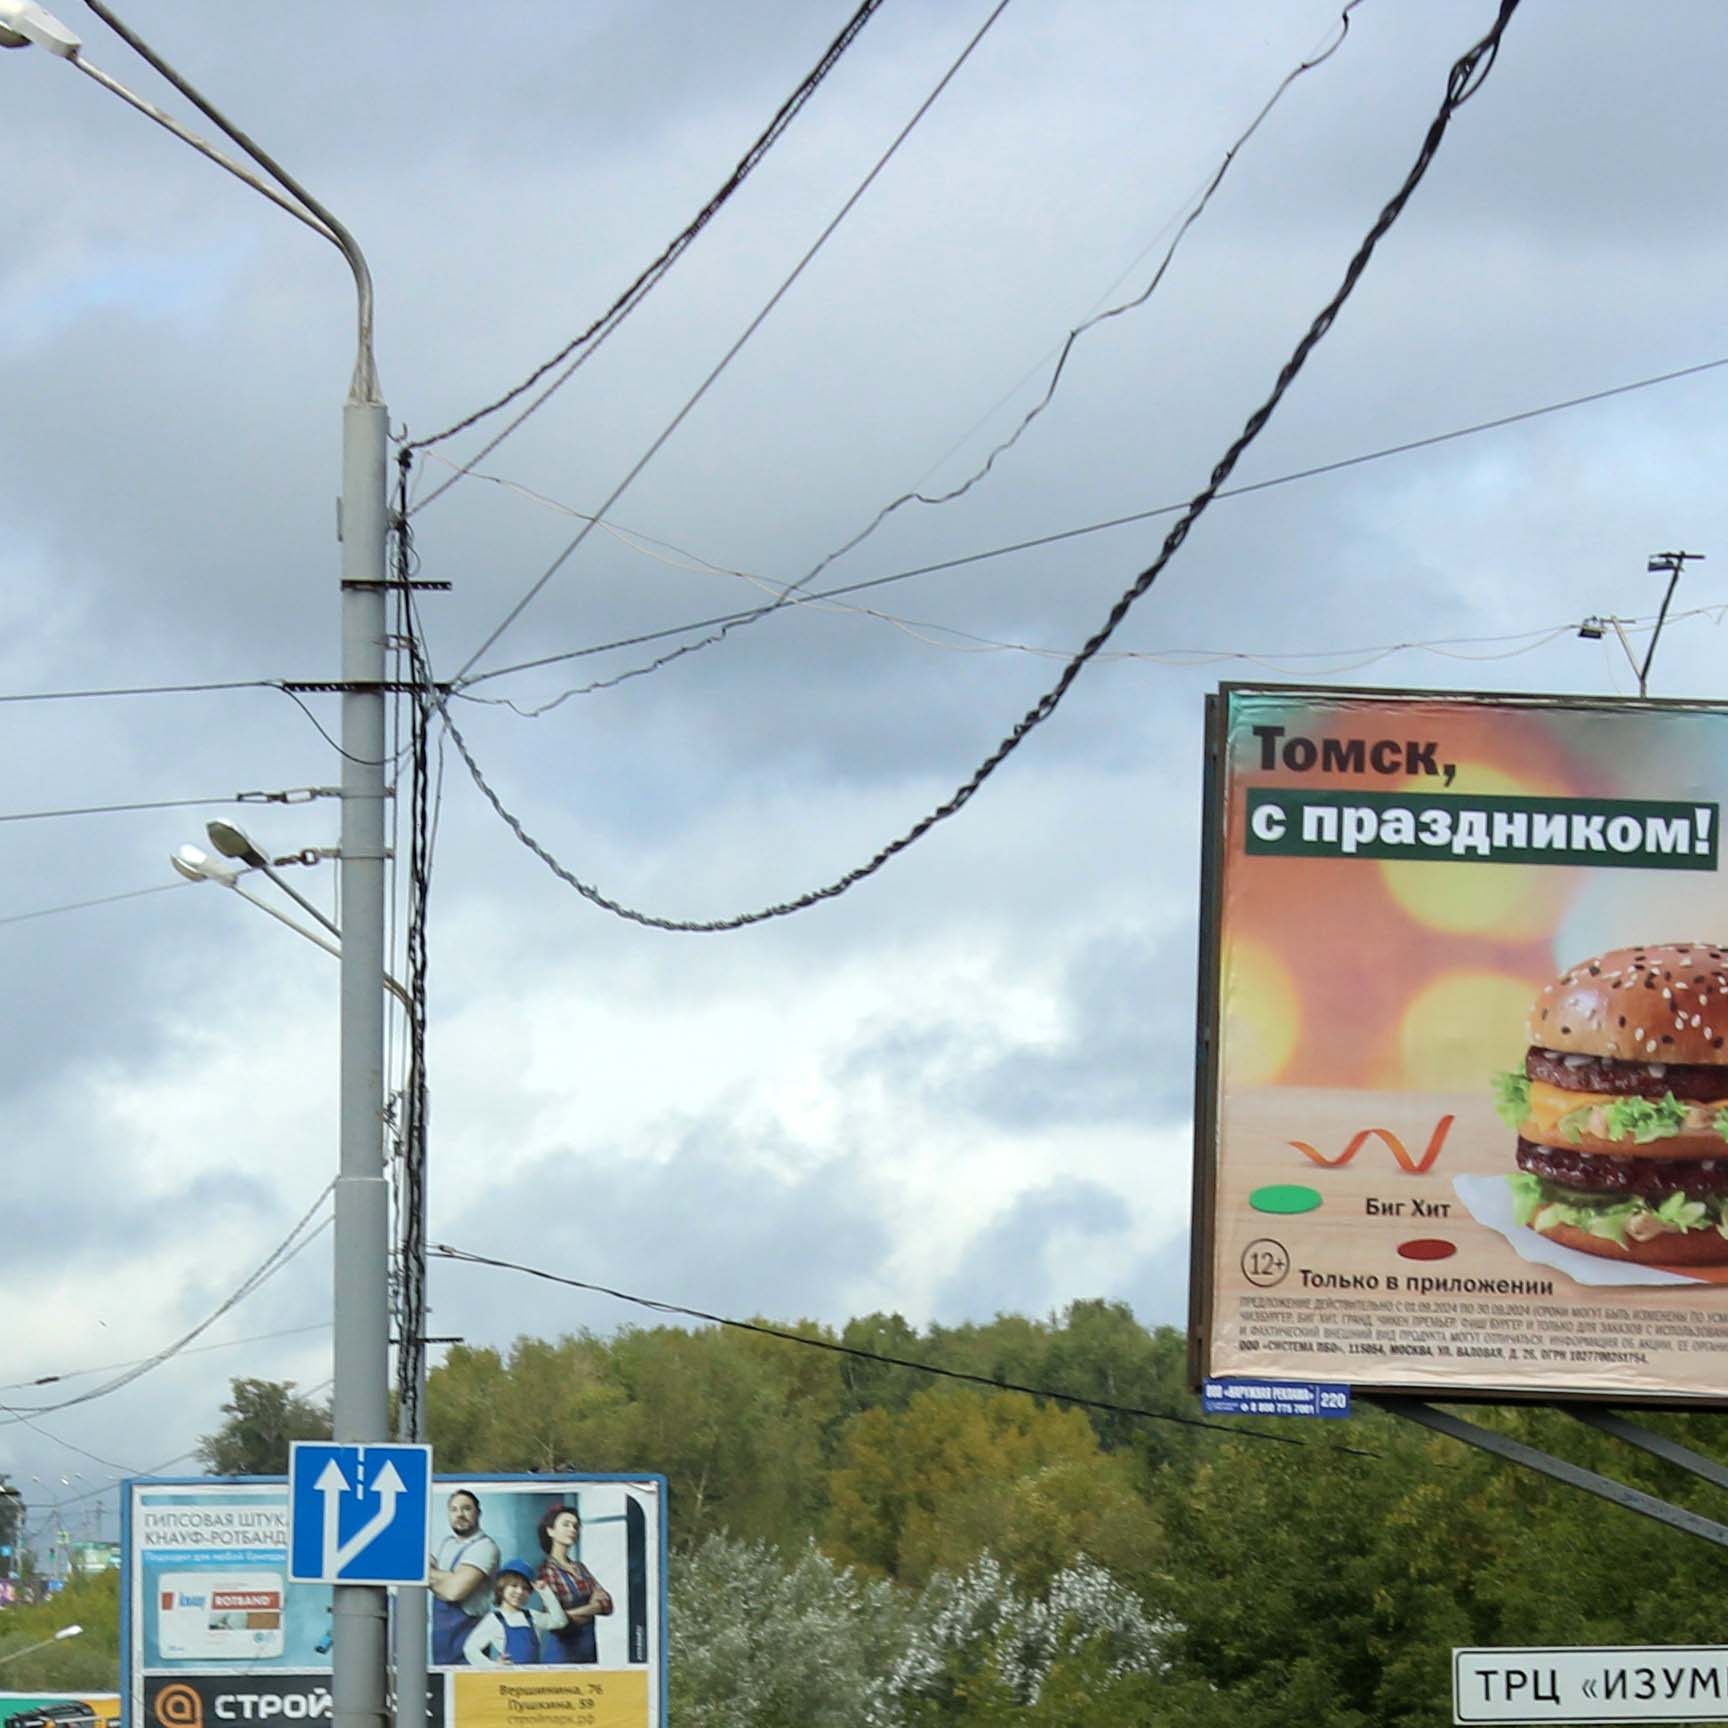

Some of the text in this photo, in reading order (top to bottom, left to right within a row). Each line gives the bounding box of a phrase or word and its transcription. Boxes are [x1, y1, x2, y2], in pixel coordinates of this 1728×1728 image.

[1253, 725, 1458, 787] Томск,
[1251, 803, 1713, 856] с праздником!
[1365, 1196, 1451, 1220] Биг Хит
[1249, 1252, 1285, 1276] 12+
[1300, 1269, 1555, 1297] Только в приложении
[1320, 1392, 1346, 1408] 220
[144, 1513, 233, 1528] ГИПСОВАЯ
[215, 1596, 271, 1607] ROTBAND
[1476, 1669, 1560, 1705] ТРЦ
